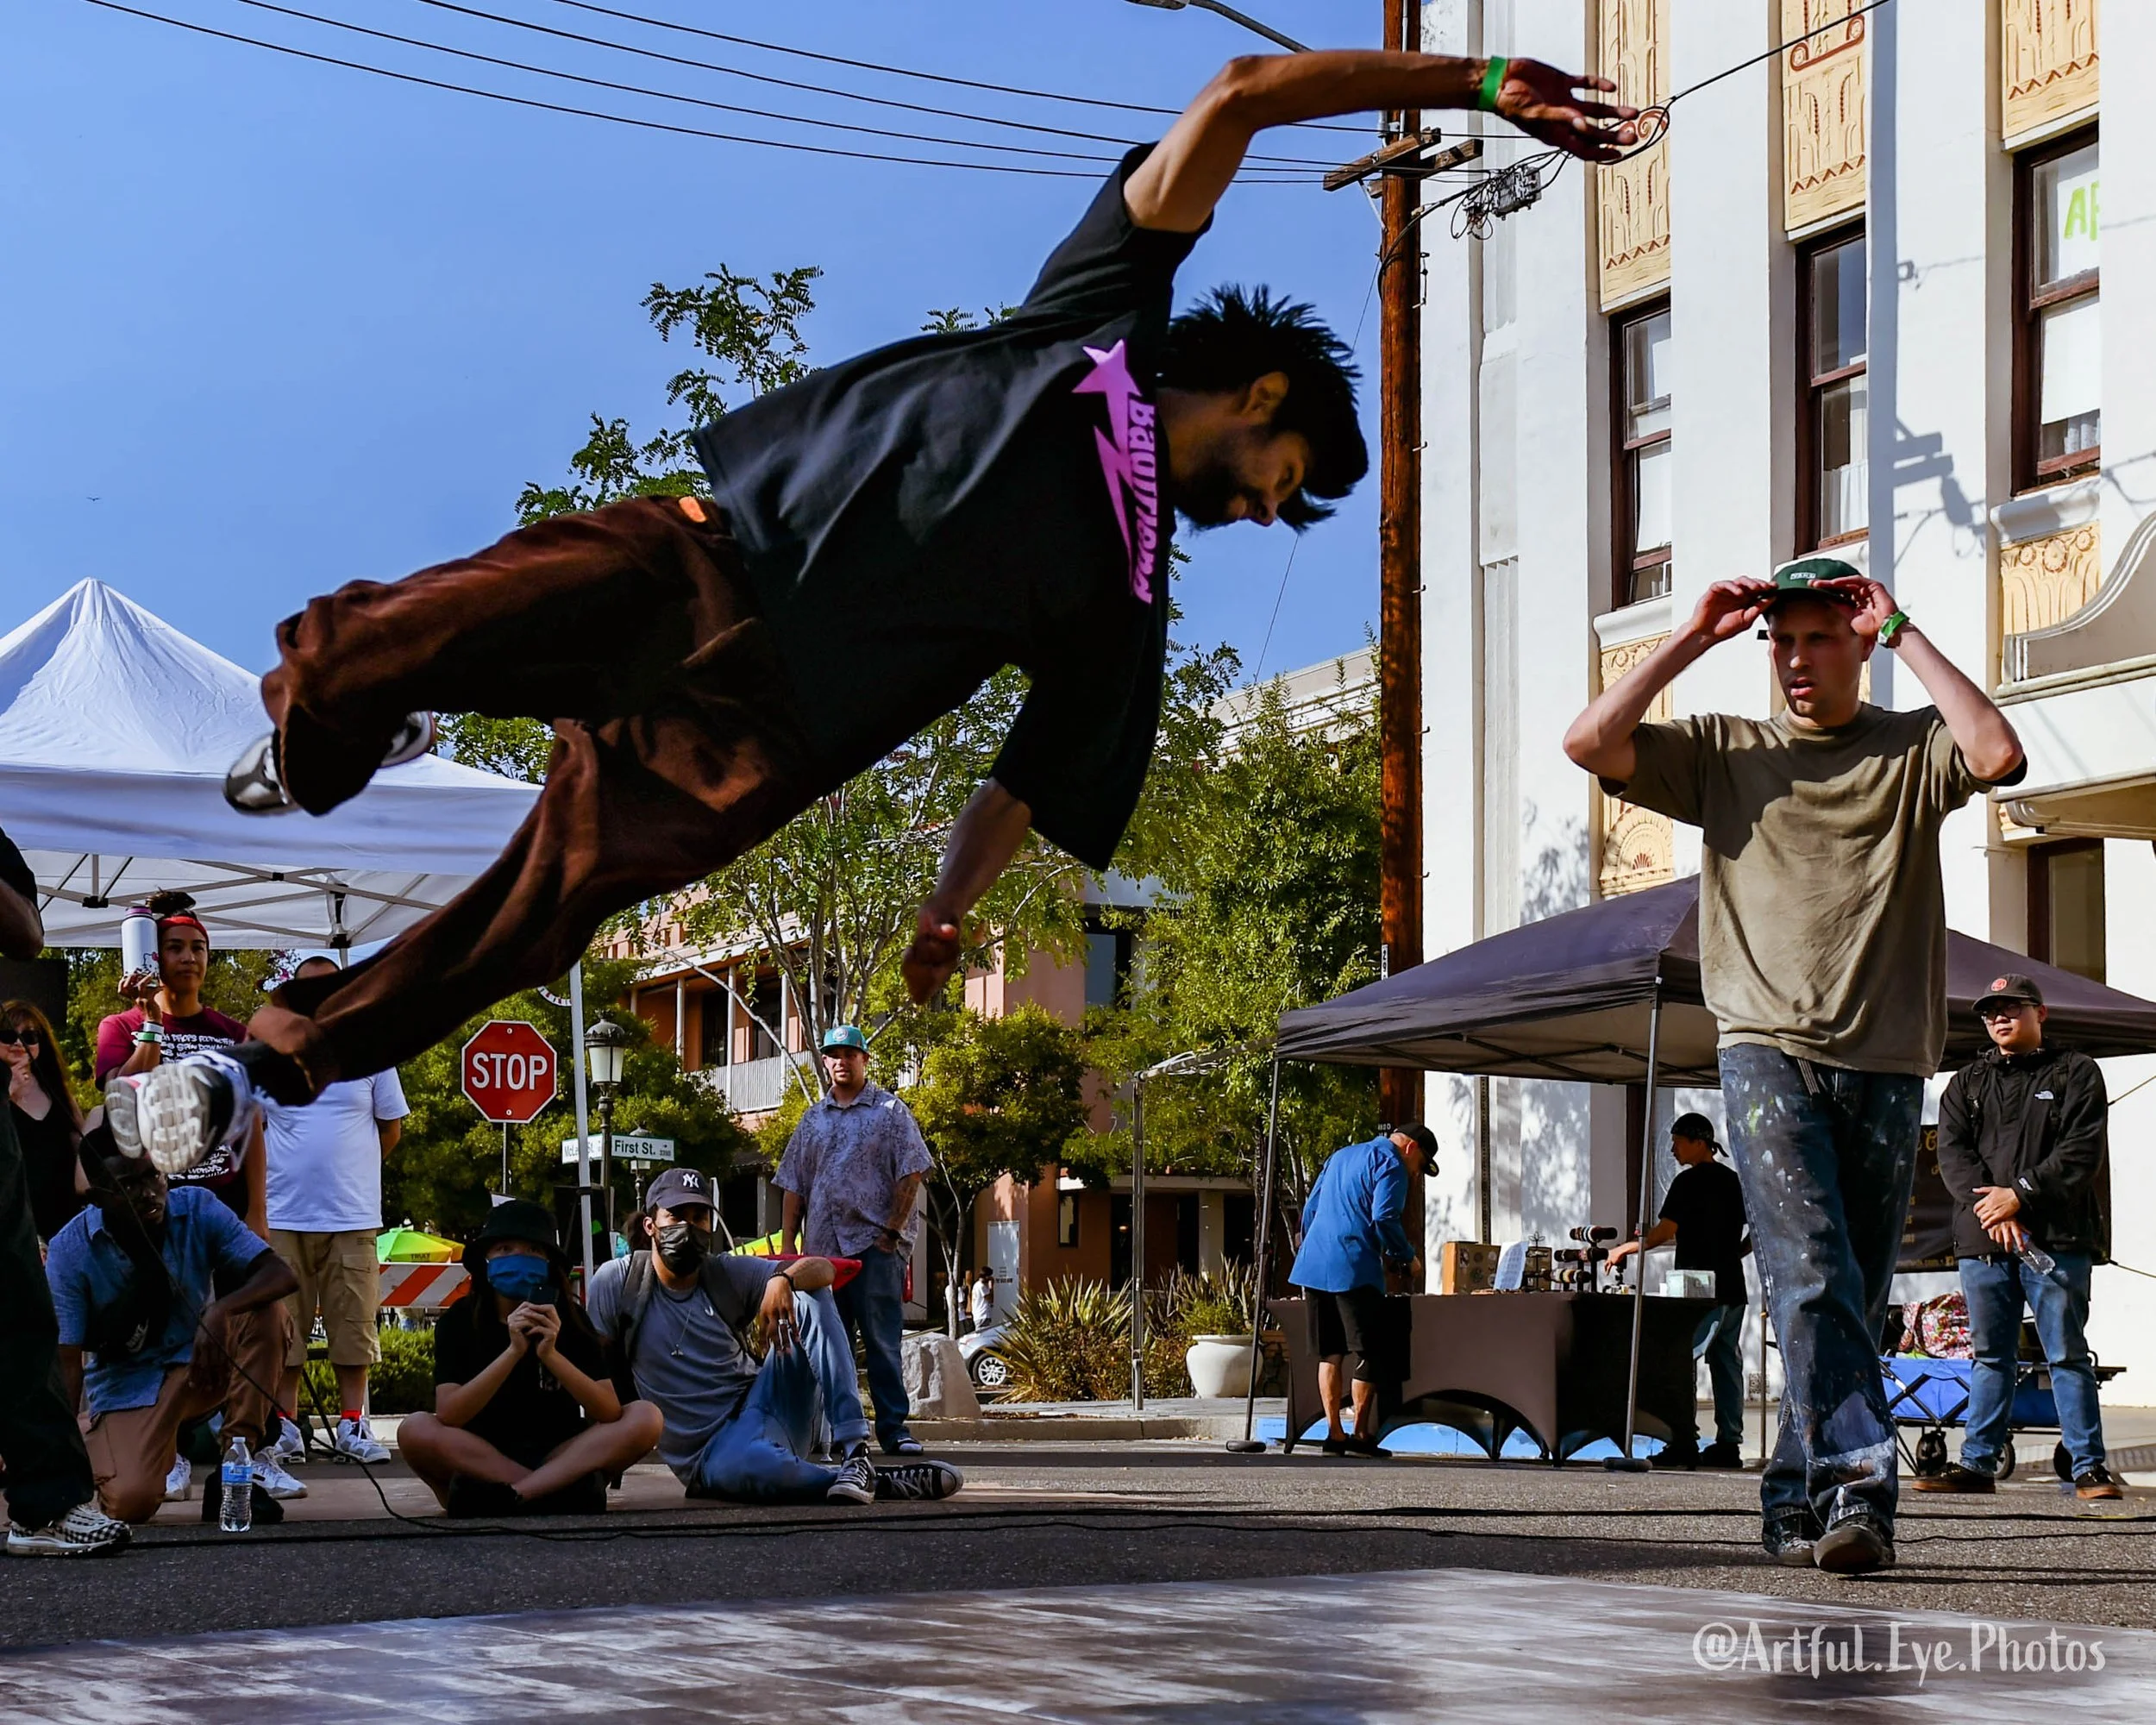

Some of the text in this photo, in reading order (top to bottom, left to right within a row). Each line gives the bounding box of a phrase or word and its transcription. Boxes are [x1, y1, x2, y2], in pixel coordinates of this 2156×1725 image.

[472, 1052, 548, 1090] STOP
[614, 1139, 639, 1154] First
[642, 1142, 656, 1156] St.
[682, 1173, 699, 1189] NY
